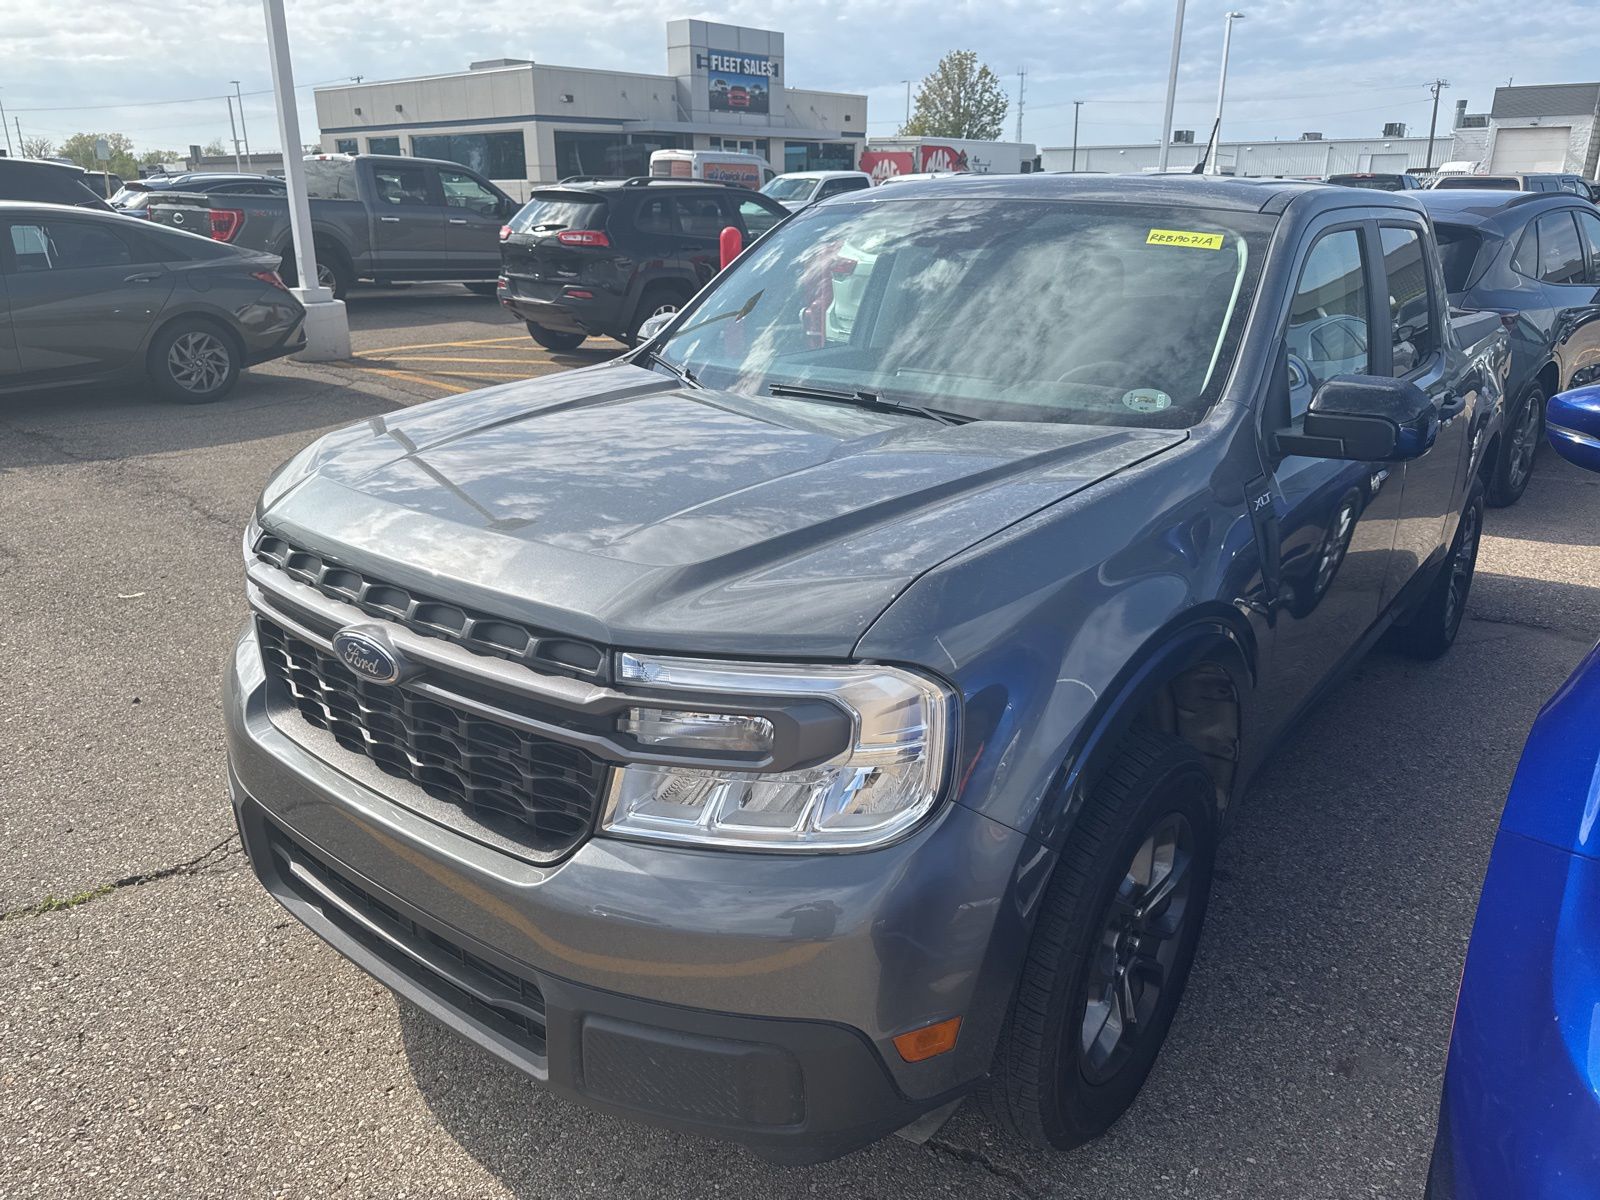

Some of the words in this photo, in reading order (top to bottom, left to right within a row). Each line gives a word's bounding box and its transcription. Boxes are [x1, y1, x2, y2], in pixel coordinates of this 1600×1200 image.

[711, 54, 742, 74] FLEET
[743, 58, 774, 77] SALES
[926, 149, 954, 172] MAC
[1253, 491, 1271, 511] XLT
[344, 641, 379, 675] Ford
